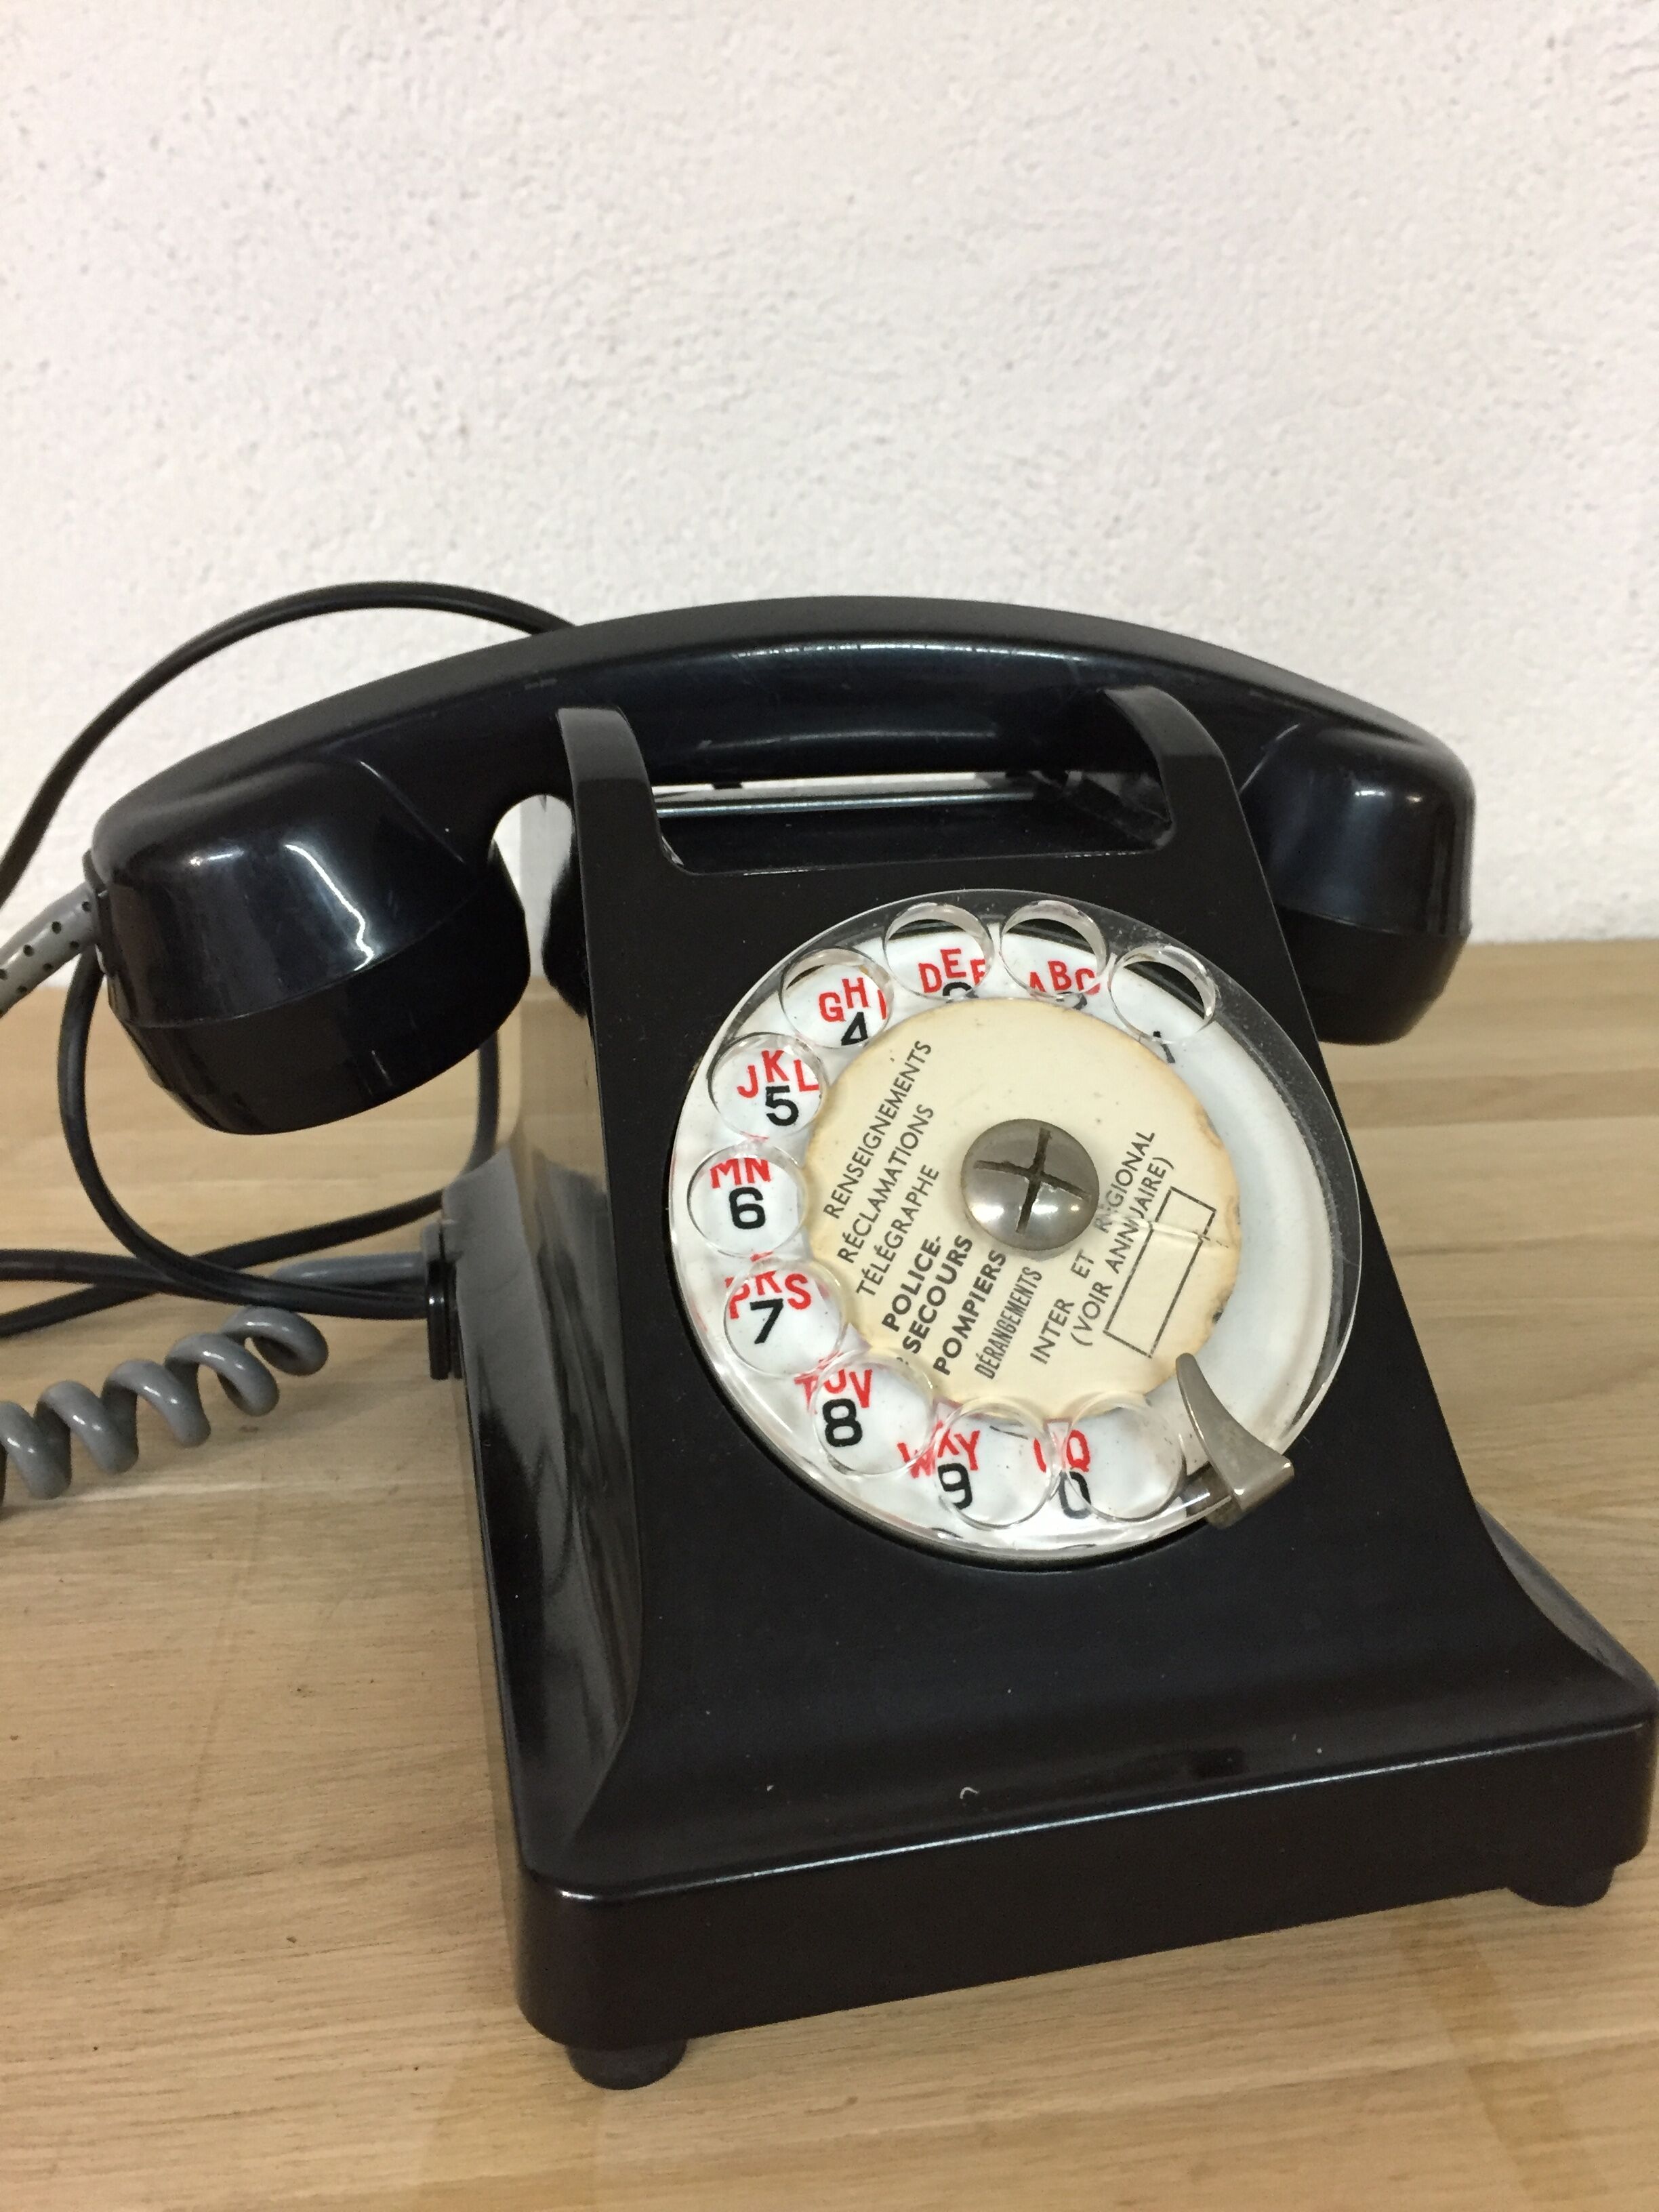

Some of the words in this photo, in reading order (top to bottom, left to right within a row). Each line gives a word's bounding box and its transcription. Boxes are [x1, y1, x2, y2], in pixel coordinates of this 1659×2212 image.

[737, 1050, 819, 1098] JKL
[765, 1086, 798, 1126] 5
[823, 1040, 931, 1218] RENSEIGNEMENTS
[710, 1158, 771, 1189] MN
[729, 1187, 766, 1229] 6
[838, 1104, 934, 1264] RÉCLAMATIONS
[857, 1164, 939, 1297] TÉLÉGRAPHE
[1030, 1298, 1074, 1364] INTER
[1071, 1248, 1094, 1279] ET
[1092, 1132, 1155, 1233] RGIONAL
[750, 1298, 783, 1344] 7
[882, 1236, 941, 1332] POLICE-
[903, 1235, 973, 1354] SECOURS
[933, 1250, 1006, 1376] POMPIERS
[975, 1266, 1042, 1380] DÉRANGEMENTS
[1071, 1281, 1113, 1347] (VOIR
[823, 1398, 863, 1447] 8
[938, 1463, 972, 1510] 9
